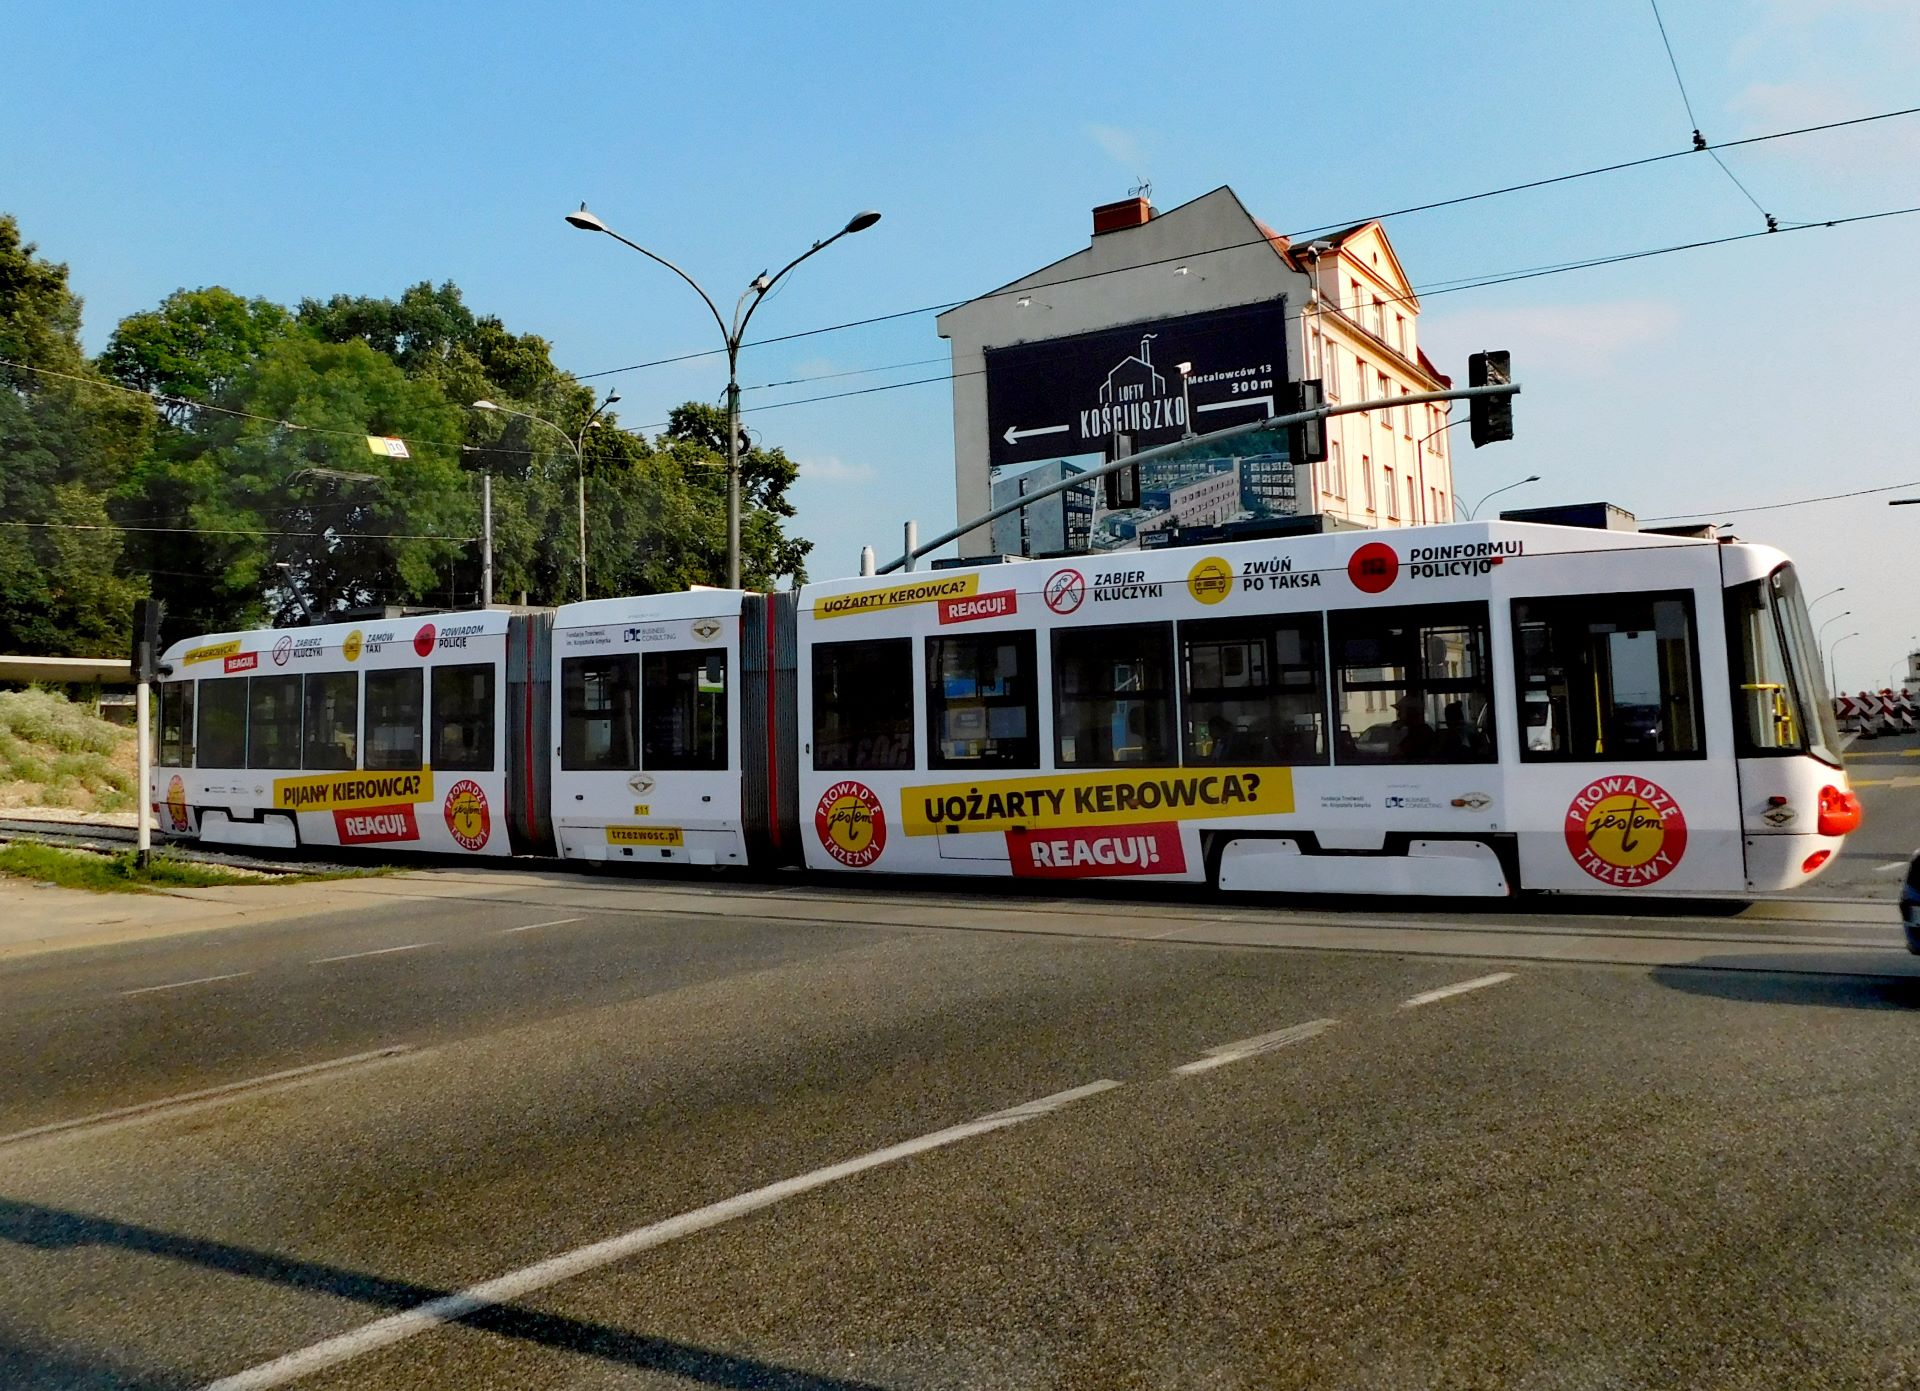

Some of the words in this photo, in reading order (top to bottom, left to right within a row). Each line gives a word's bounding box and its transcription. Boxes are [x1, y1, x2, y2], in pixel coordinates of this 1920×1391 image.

[1187, 367, 1256, 384] Metalowców
[1259, 364, 1272, 373] 13
[1119, 383, 1144, 402] LOFTY
[1231, 379, 1273, 393] 300m
[1080, 396, 1185, 439] KOŚCIUSZKO
[1410, 540, 1523, 562] POINFORMUJ
[1243, 577, 1264, 591] PO
[1269, 573, 1321, 589] TAKSA
[824, 593, 886, 613] UOŻARTY
[889, 581, 966, 603] KEROWCA?
[1094, 585, 1163, 602] KLUCZYKI
[948, 596, 1007, 618] REAGUJ!
[366, 631, 395, 643] ZAMÓW
[440, 625, 484, 637] POWIADOM
[293, 647, 323, 658] KLUCZYKI
[294, 638, 322, 647] ZABIERZ
[365, 643, 381, 653] TAXI
[283, 783, 330, 807] PIJANY
[332, 775, 421, 801] KIEROWCA?
[925, 788, 1065, 823] UOŻARTY
[1074, 773, 1261, 814] KEROWCA?
[345, 813, 407, 837] REAGUJ!
[828, 799, 873, 841] jestem
[1586, 798, 1663, 853] jestem
[611, 829, 679, 843] trzezwosc.pl
[1030, 835, 1160, 869] REAGUJ!
